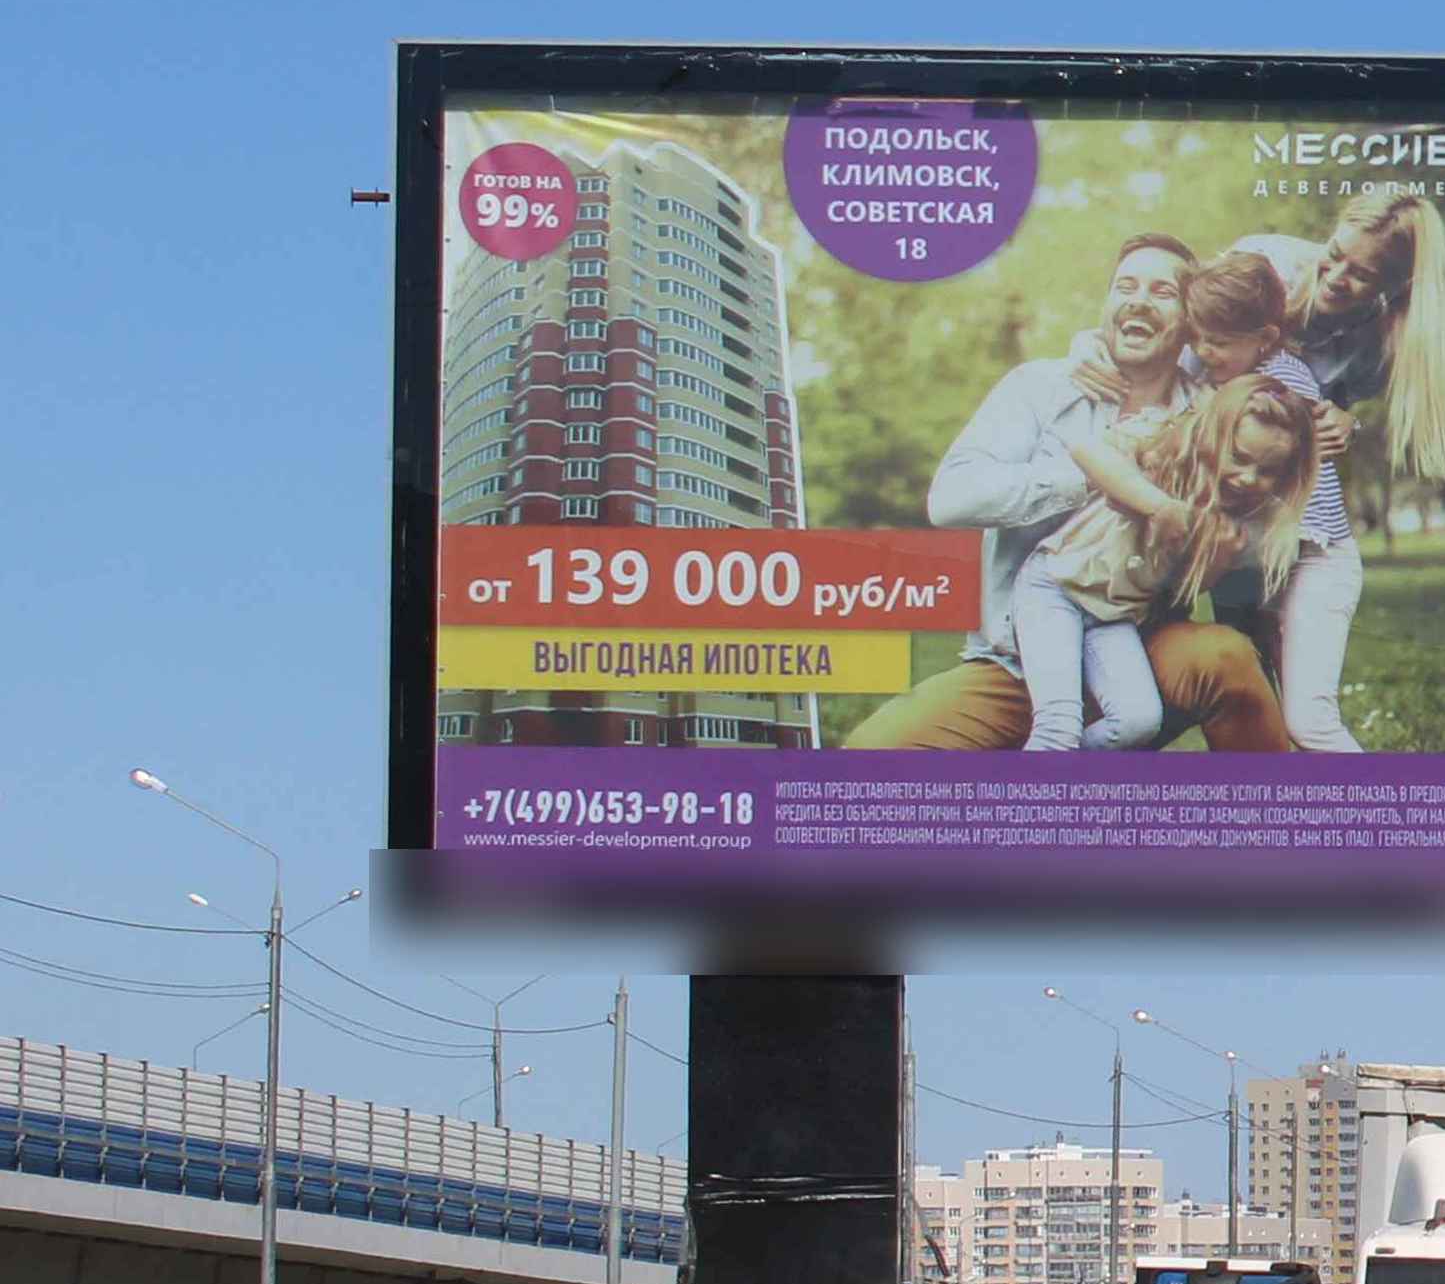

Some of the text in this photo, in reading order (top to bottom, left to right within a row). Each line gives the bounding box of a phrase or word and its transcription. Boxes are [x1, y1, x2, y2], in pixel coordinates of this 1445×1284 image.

[823, 127, 999, 155] ПОДОЛЬСК,
[473, 173, 563, 190] ГОТОВ НА
[822, 163, 1001, 190] КЛИМОВСК,
[475, 193, 560, 229] 99%
[826, 199, 994, 225] СОВЕТСКАЯ
[895, 238, 928, 260] 18
[468, 580, 512, 604] от
[527, 547, 650, 606] 139
[673, 550, 801, 608] 000
[533, 641, 833, 678] ВЫГОДНАЯ ИПОТЕКА
[776, 782, 822, 799] ИПОТЕКА
[824, 782, 922, 799] ПРЕДОСТАВЛЯЕТСЯ
[925, 782, 953, 799] БАНК
[955, 783, 974, 800] ВТБ
[976, 783, 1006, 800] (ПАО)
[1007, 783, 1067, 800] ОКАЗЫВАЕТ
[1070, 784, 1160, 801] ИСКЛЮЧИТЕЛЬНО
[1162, 784, 1229, 801] БАНКОВСКИЕ
[1276, 785, 1304, 802] БАНК
[1306, 785, 1345, 802] ВПРАВЕ
[1347, 785, 1398, 802] ОТКАЗАТЬ
[1400, 786, 1408, 802] В
[463, 788, 754, 826] +7(499)653-98-18
[776, 804, 821, 821] КРЕДИТА
[824, 804, 843, 821] БЕЗ
[846, 805, 916, 821] ОБЪЯСНЕНИЯ
[966, 806, 993, 822] БАНК
[995, 806, 1080, 823] ПРЕДОСТАВЛЯЕТ
[1082, 806, 1122, 823] КРЕДИТ
[1125, 806, 1133, 822] В
[1179, 807, 1207, 823] ЕСЛИ
[1209, 807, 1261, 825] ЗАЕМЩИК
[1406, 808, 1427, 824] ПРИ
[463, 830, 752, 850] www.messier-development.group
[776, 827, 855, 844] СООТВЕТСТВУЕТ
[858, 827, 934, 844] ТРЕБОВАНИЯМ
[936, 828, 970, 844] БАНКА
[973, 828, 980, 844] И
[983, 828, 1056, 845] ПРЕДОСТАВИЛ
[1058, 827, 1103, 845] ПОЛНЫЙ
[1105, 829, 1137, 845] ПАКЕТ
[1140, 829, 1218, 847] НЕОБХОДИМЫХ
[1294, 830, 1321, 846] БАНК
[1324, 830, 1343, 846] ВТБ
